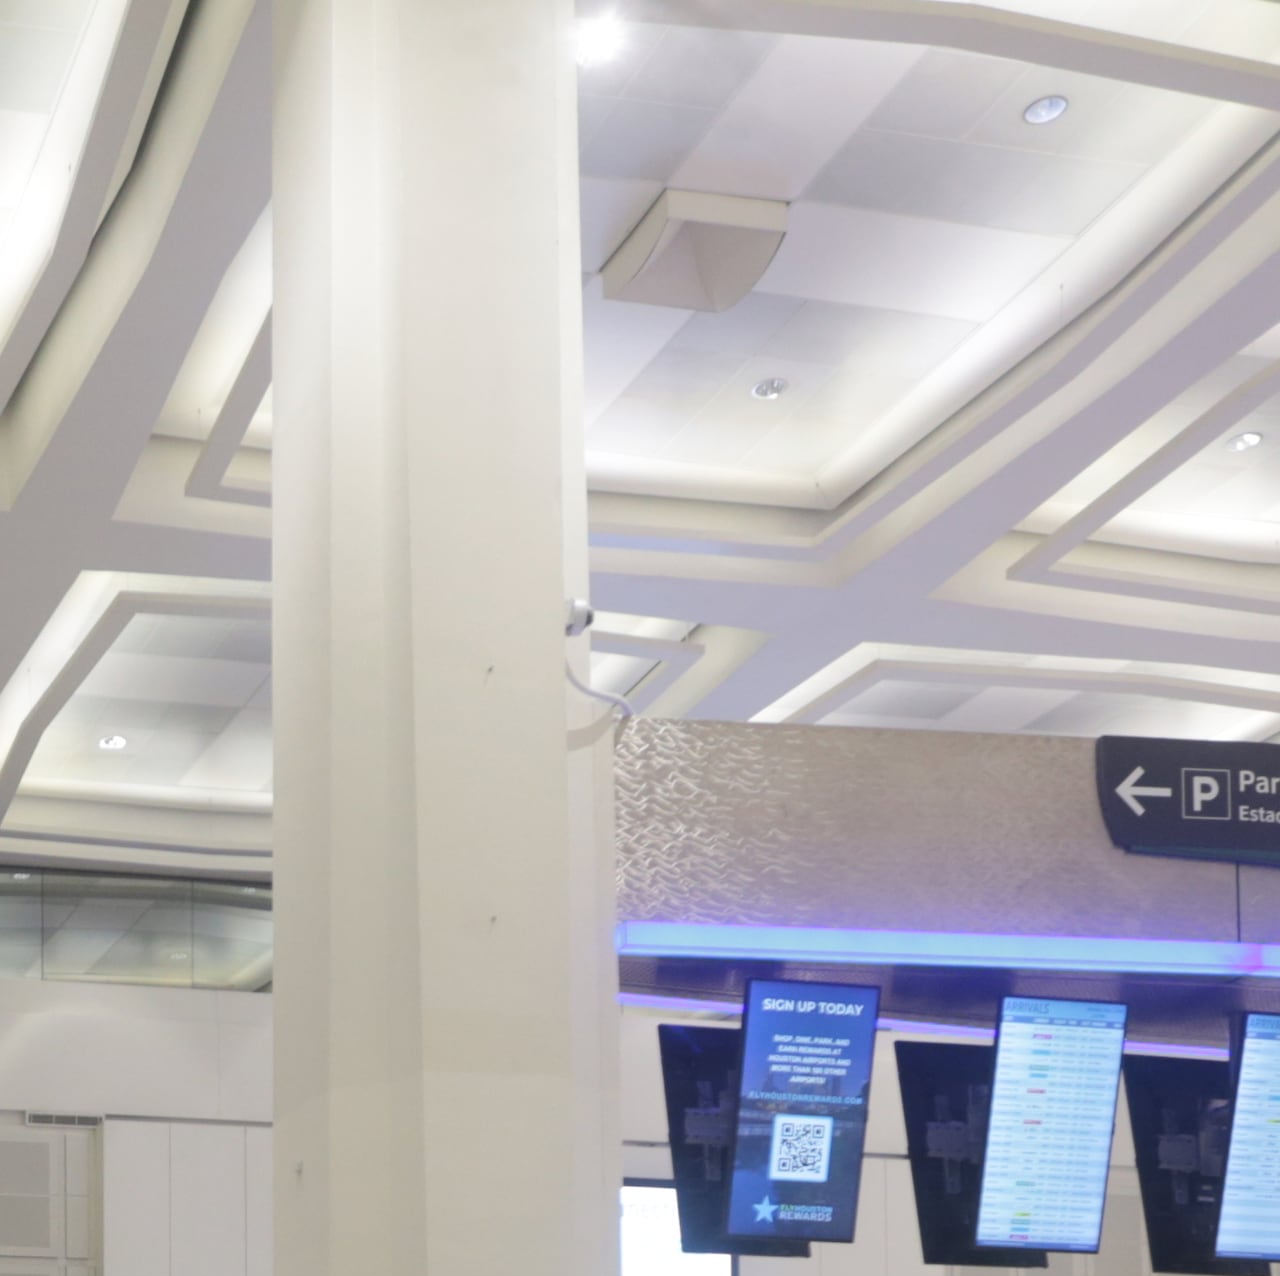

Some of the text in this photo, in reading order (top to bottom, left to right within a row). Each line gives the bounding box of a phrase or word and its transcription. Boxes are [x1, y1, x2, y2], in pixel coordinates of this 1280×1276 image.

[1192, 775, 1220, 812] P
[762, 998, 865, 1016] SIGN UP TODAY
[779, 1211, 833, 1222] REWARDS
